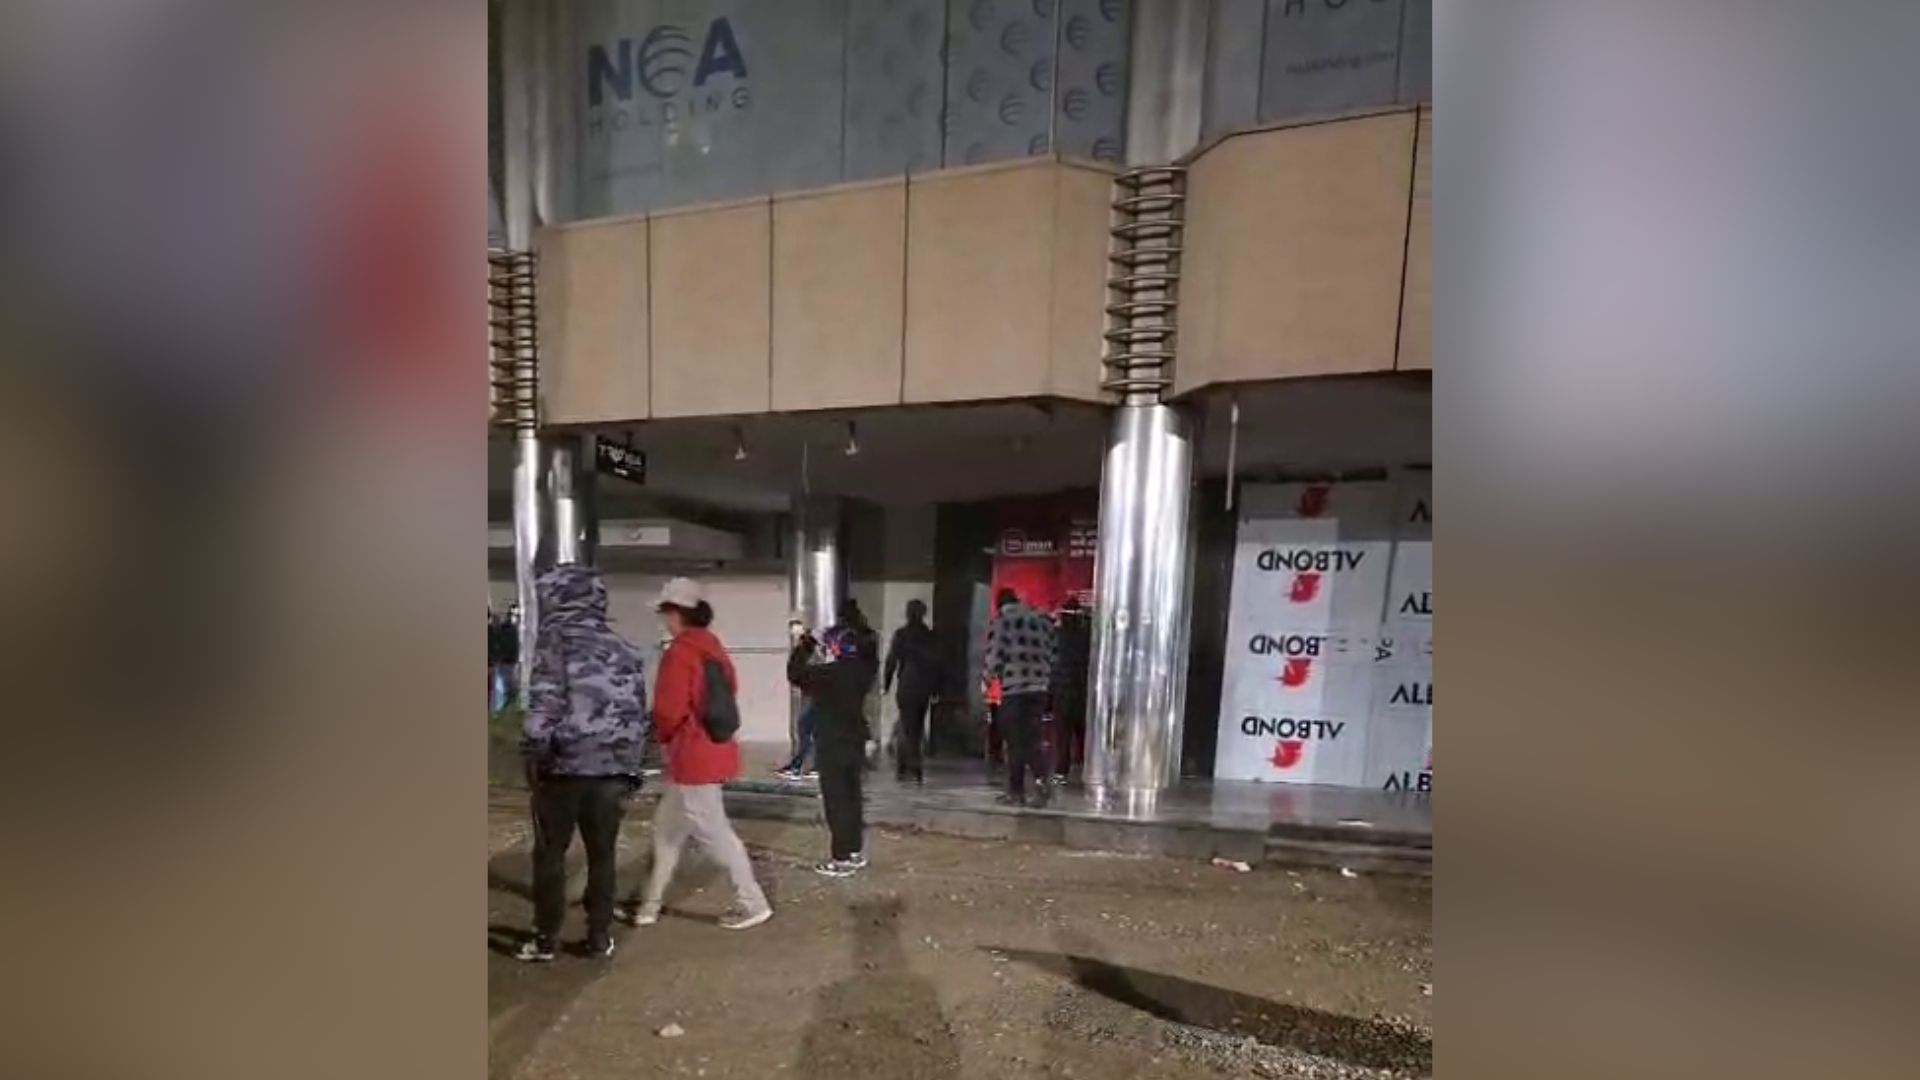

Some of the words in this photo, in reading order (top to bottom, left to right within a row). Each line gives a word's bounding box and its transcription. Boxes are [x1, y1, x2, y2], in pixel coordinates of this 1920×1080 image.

[1409, 499, 1432, 522] A
[1256, 549, 1365, 572] ALBOND
[1249, 635, 1327, 656] BOND
[1241, 716, 1345, 740] ALBOND
